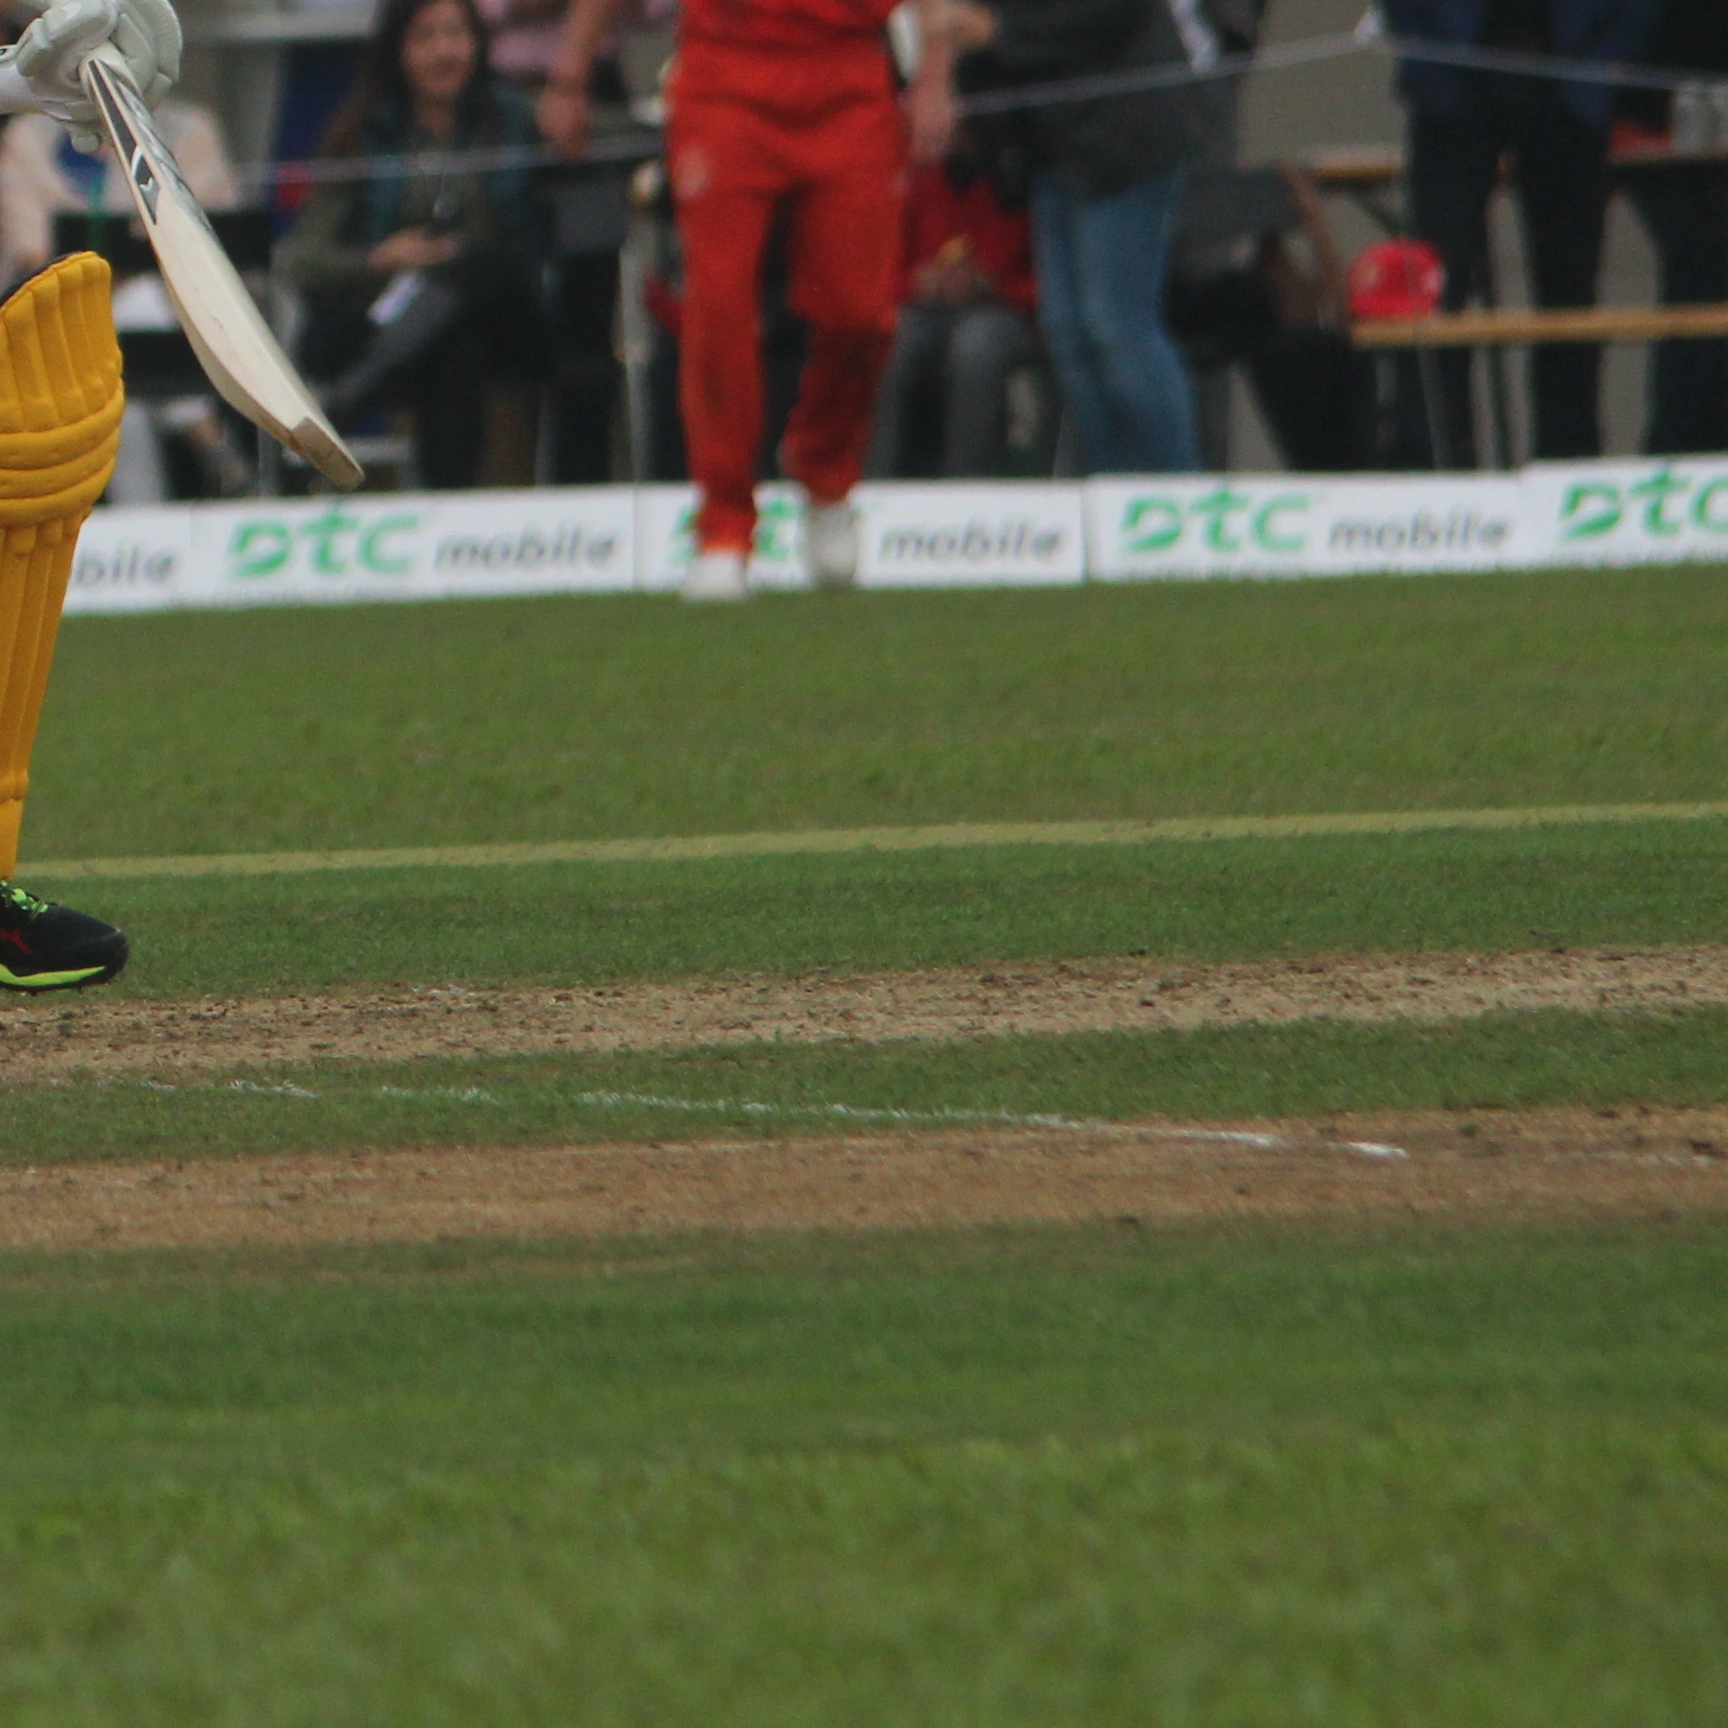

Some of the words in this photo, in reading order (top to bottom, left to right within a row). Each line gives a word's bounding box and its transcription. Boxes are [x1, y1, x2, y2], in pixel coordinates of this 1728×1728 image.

[434, 516, 618, 572] mobile
[879, 510, 1065, 563] mobile
[1329, 510, 1514, 557] mobile
[72, 542, 176, 586] bile
